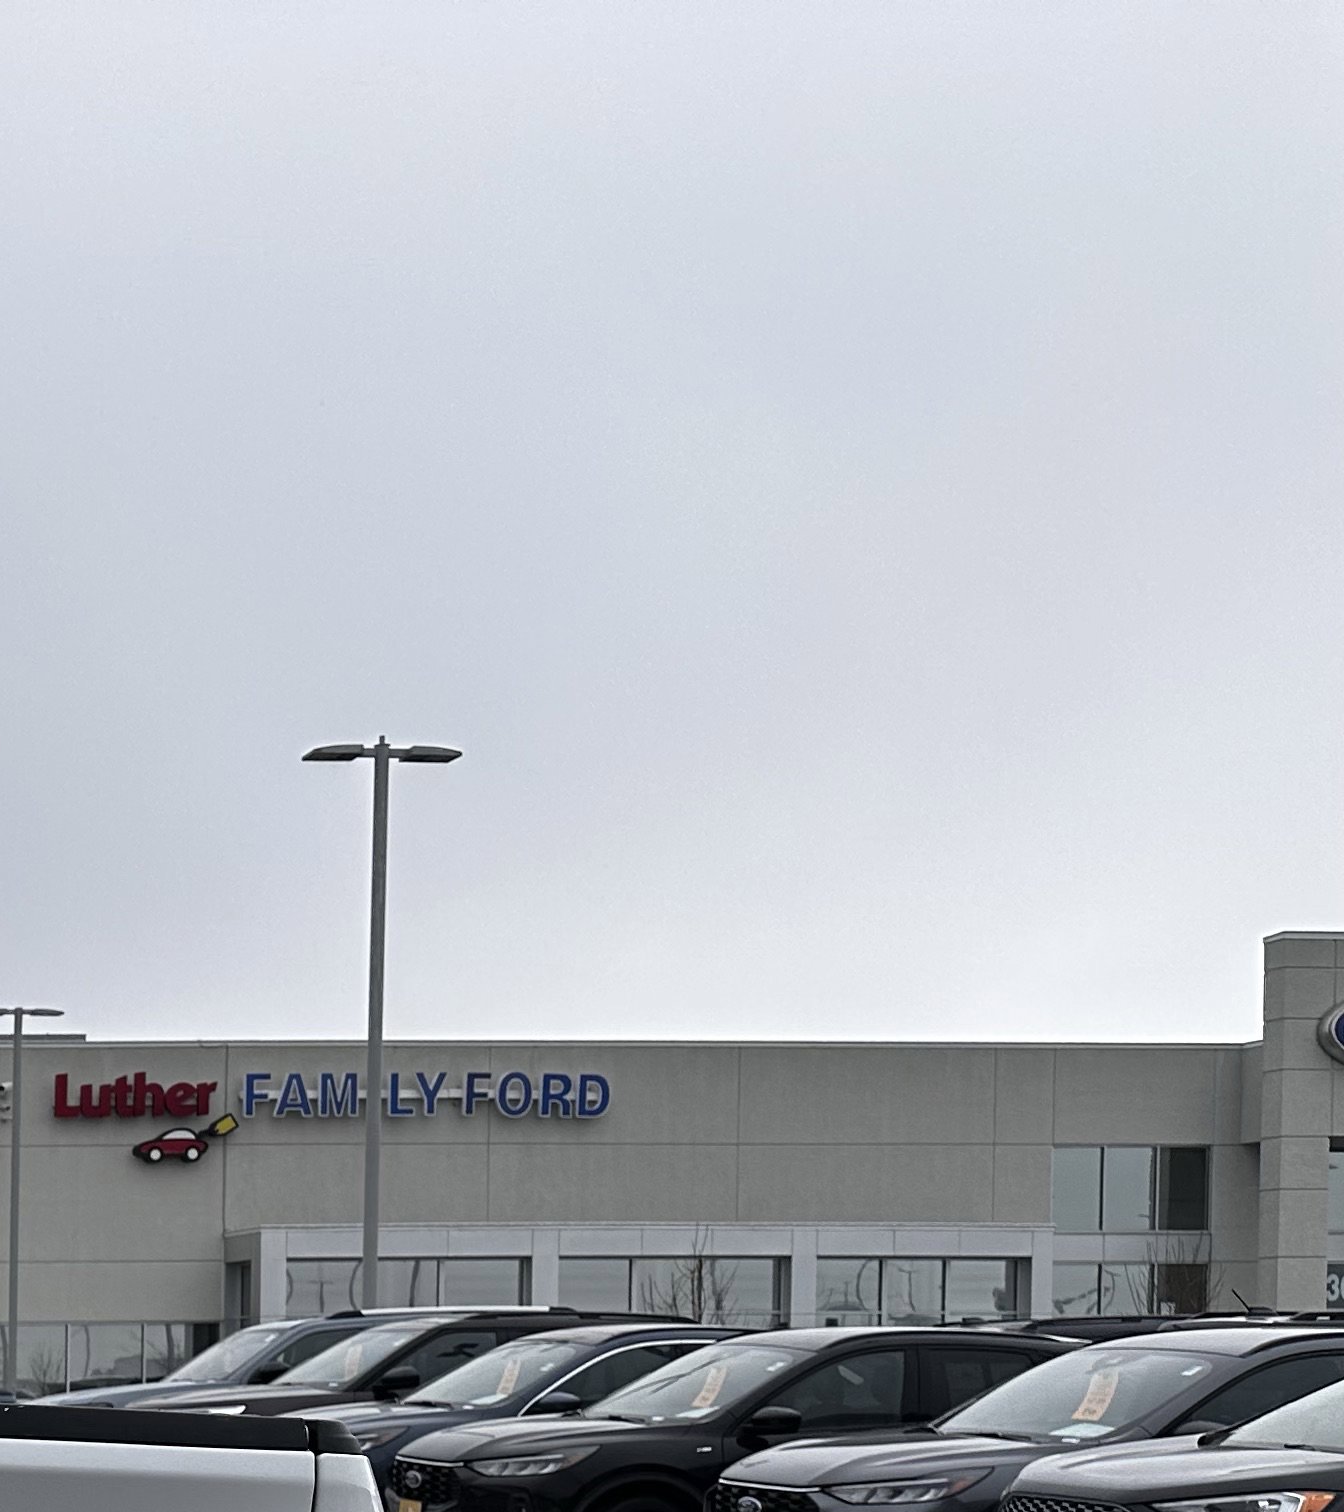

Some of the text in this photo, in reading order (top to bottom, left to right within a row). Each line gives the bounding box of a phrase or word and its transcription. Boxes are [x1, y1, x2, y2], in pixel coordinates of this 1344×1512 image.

[53, 1071, 611, 1119] Luther FAMLY FORD
